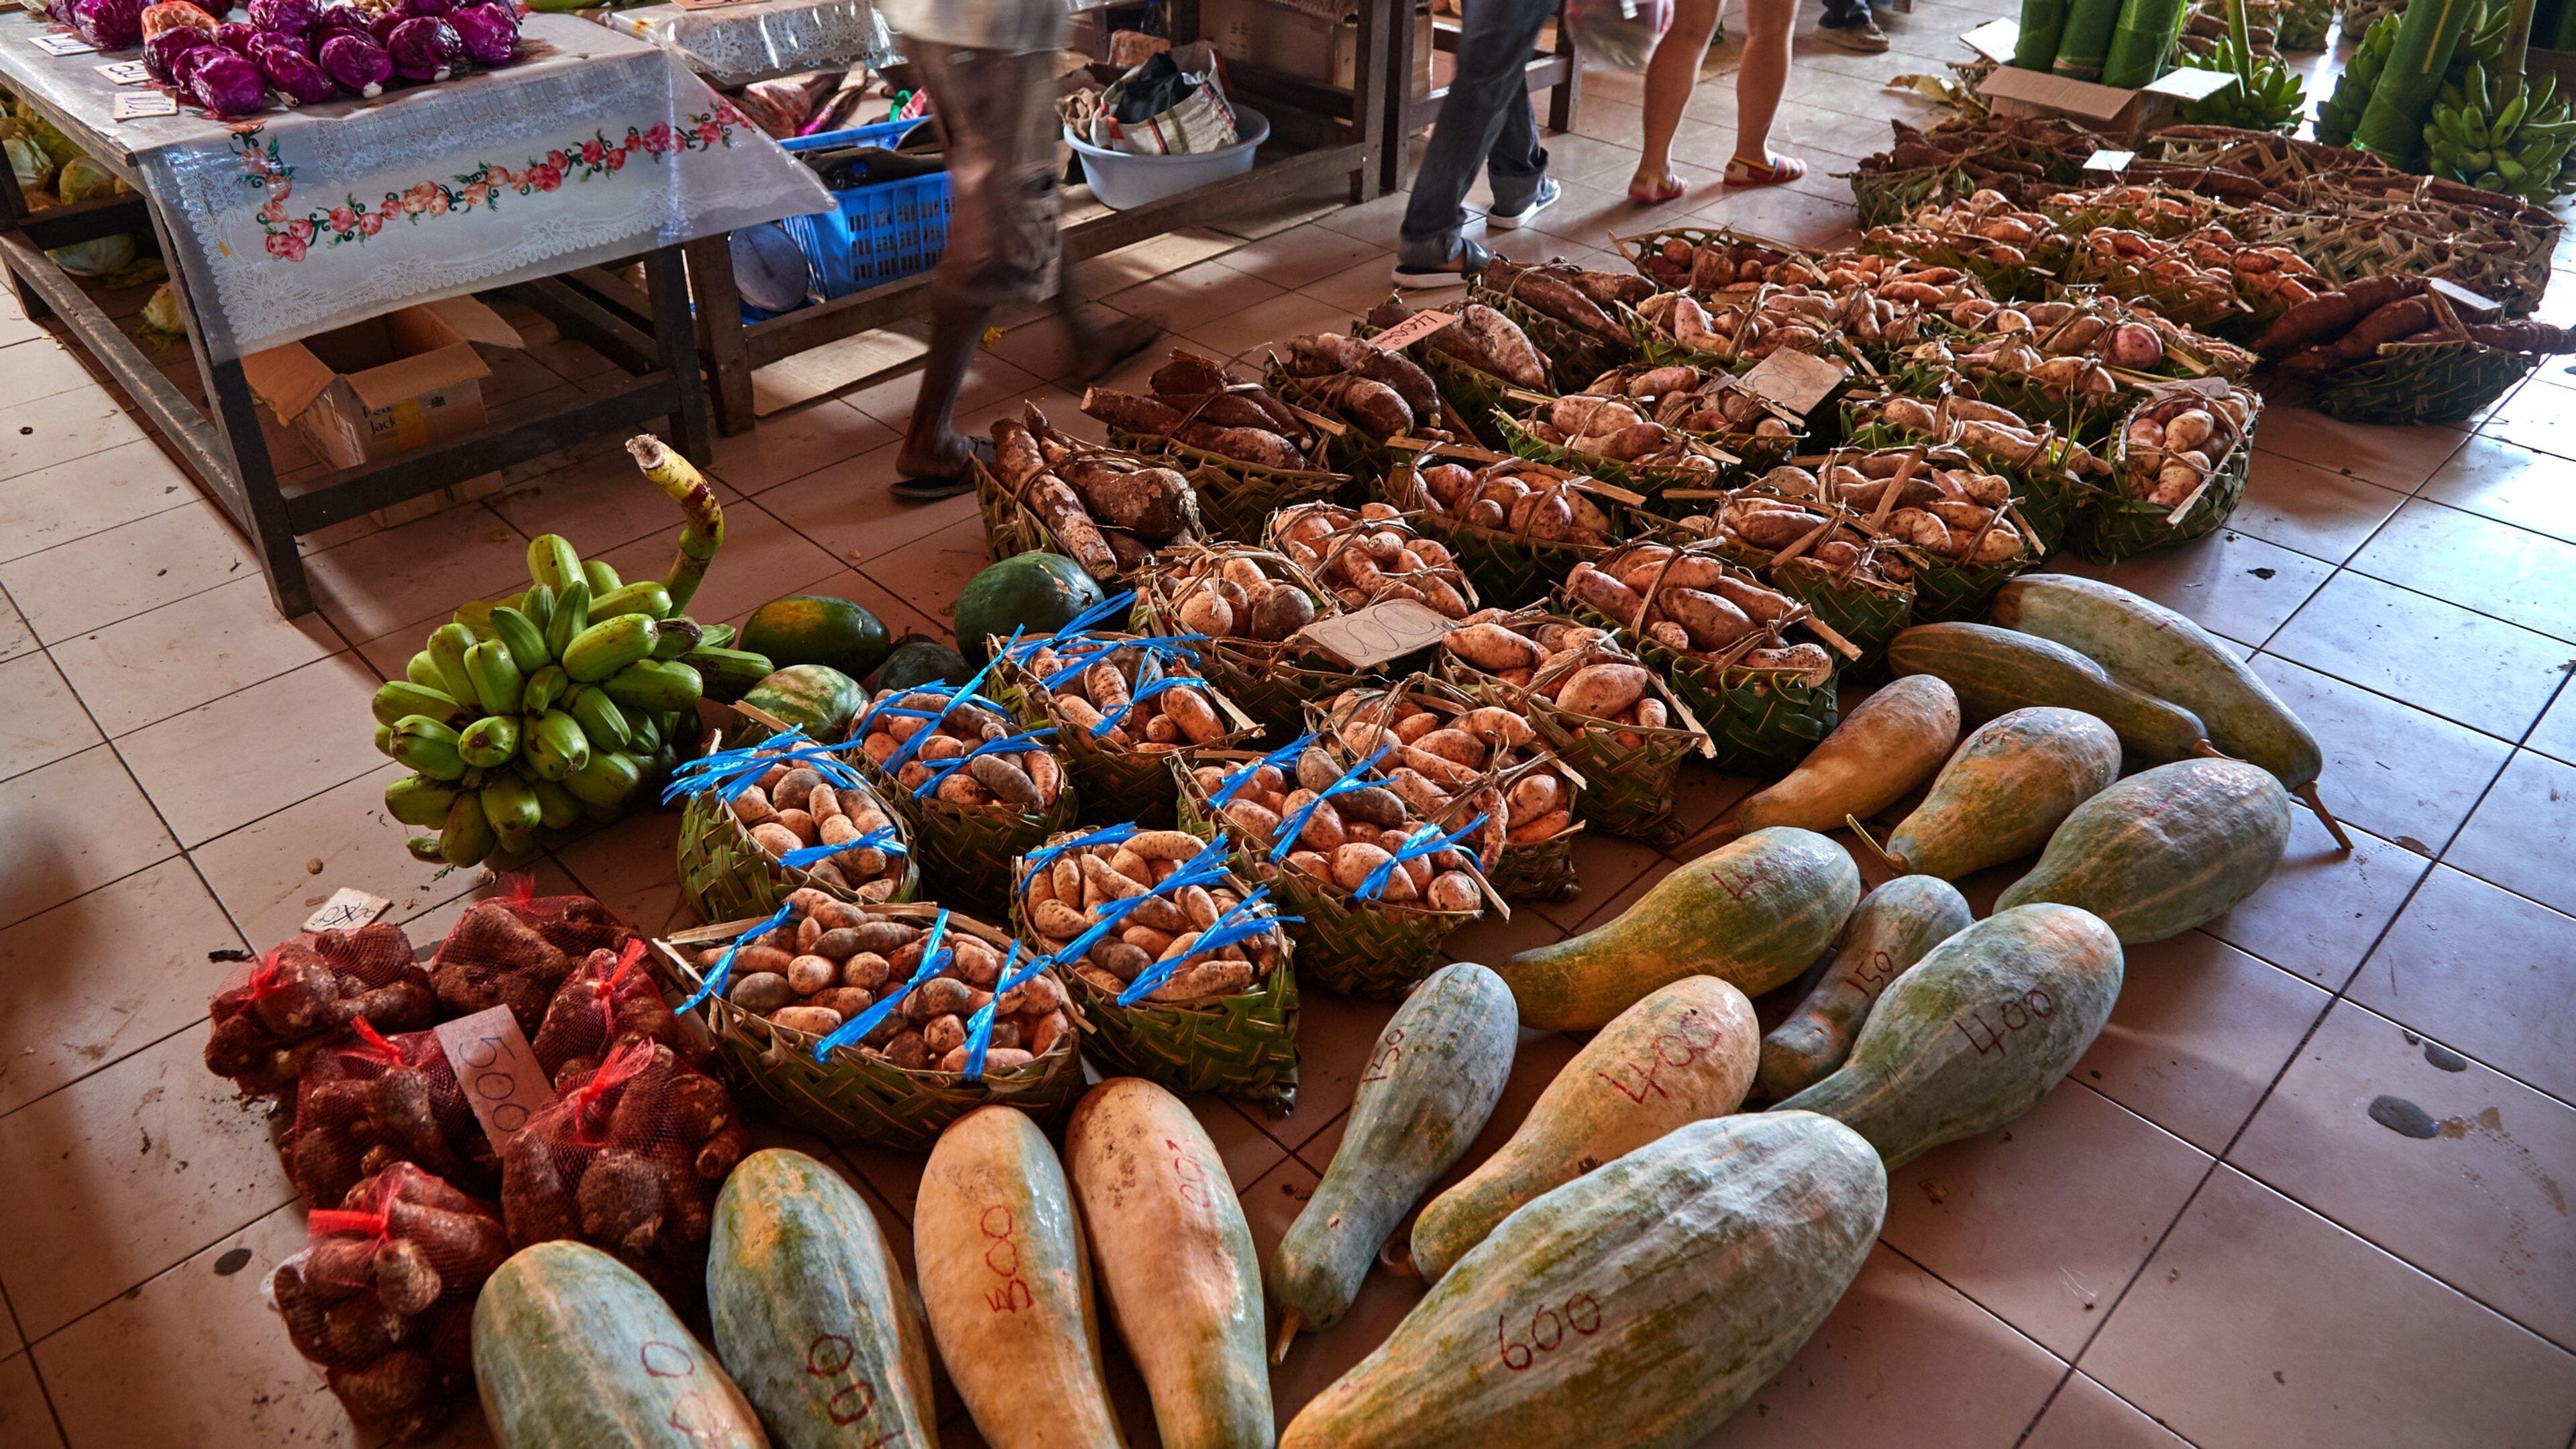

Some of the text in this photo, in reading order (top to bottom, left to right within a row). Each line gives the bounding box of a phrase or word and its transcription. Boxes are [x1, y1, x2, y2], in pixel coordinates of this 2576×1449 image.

[1845, 951, 1893, 998] 150
[1361, 1029, 1405, 1083] 150
[1597, 1011, 1722, 1104] 400
[1953, 989, 2053, 1057] 400
[458, 1037, 529, 1132] 500
[1499, 1292, 1602, 1371] 600
